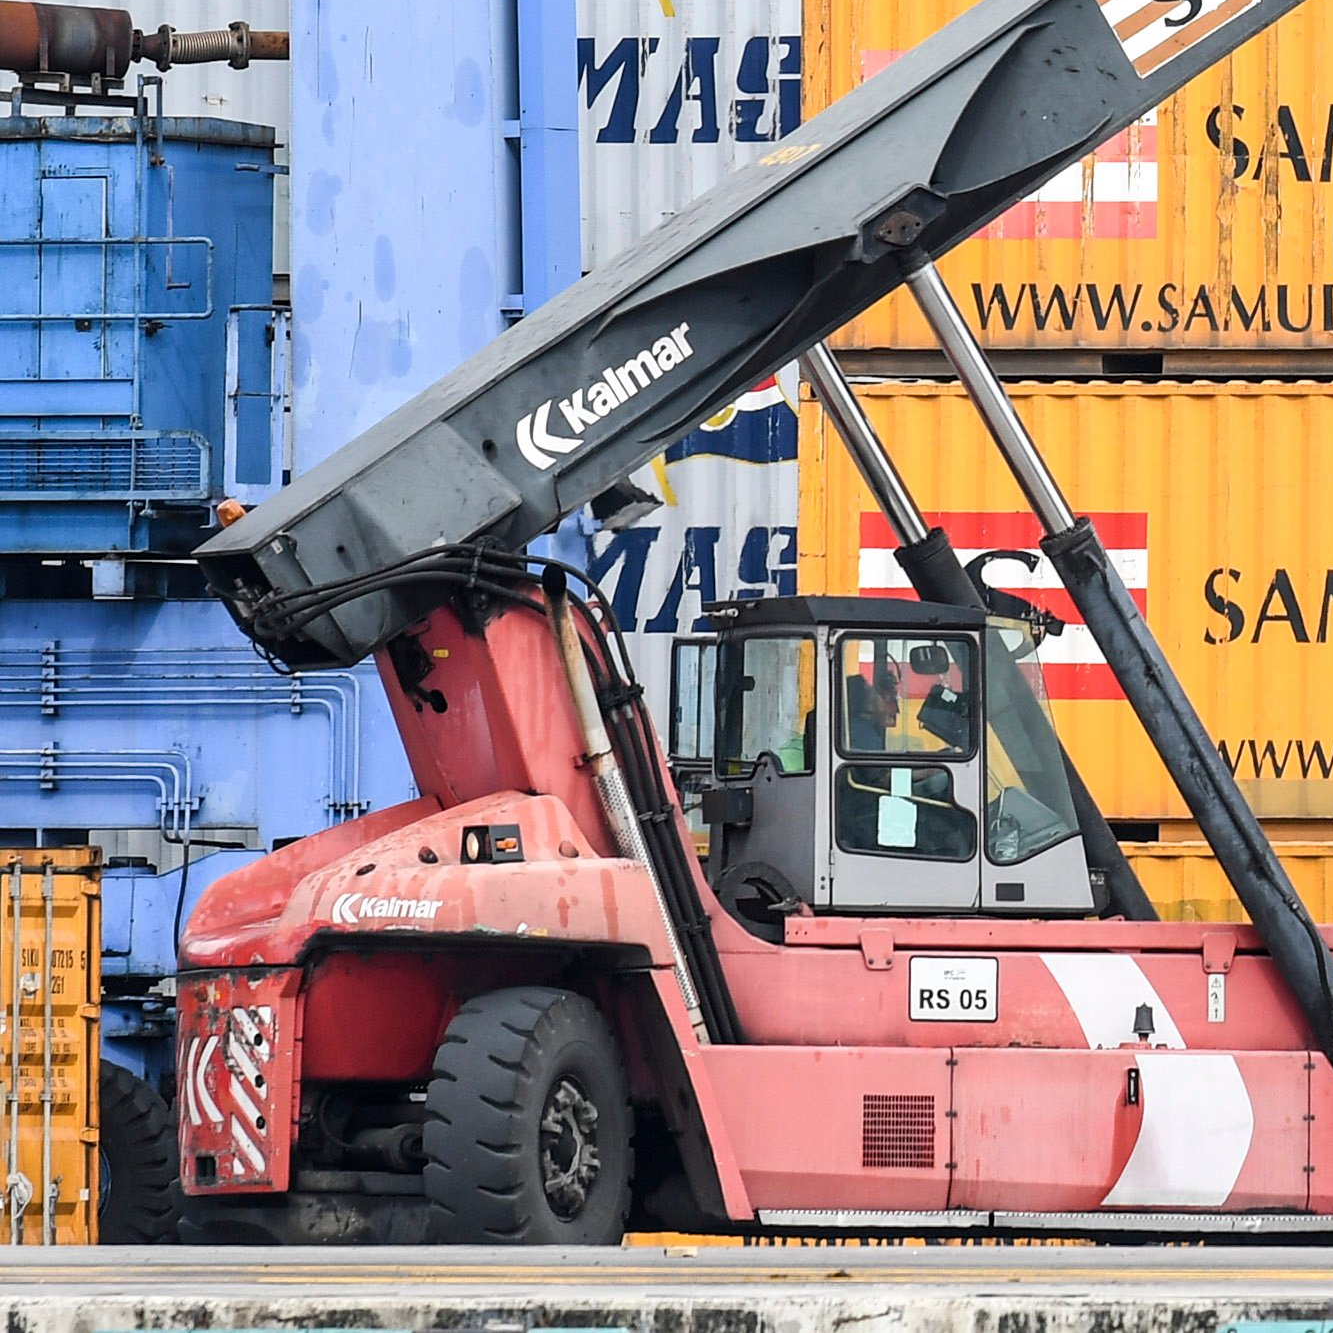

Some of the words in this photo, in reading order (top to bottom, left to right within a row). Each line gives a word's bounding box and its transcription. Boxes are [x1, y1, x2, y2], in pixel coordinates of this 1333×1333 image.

[558, 321, 695, 434] Kalmar
[357, 896, 443, 920] Kalmar
[22, 949, 38, 969] SIKU
[919, 988, 950, 1010] RS
[960, 988, 988, 1011] 05
